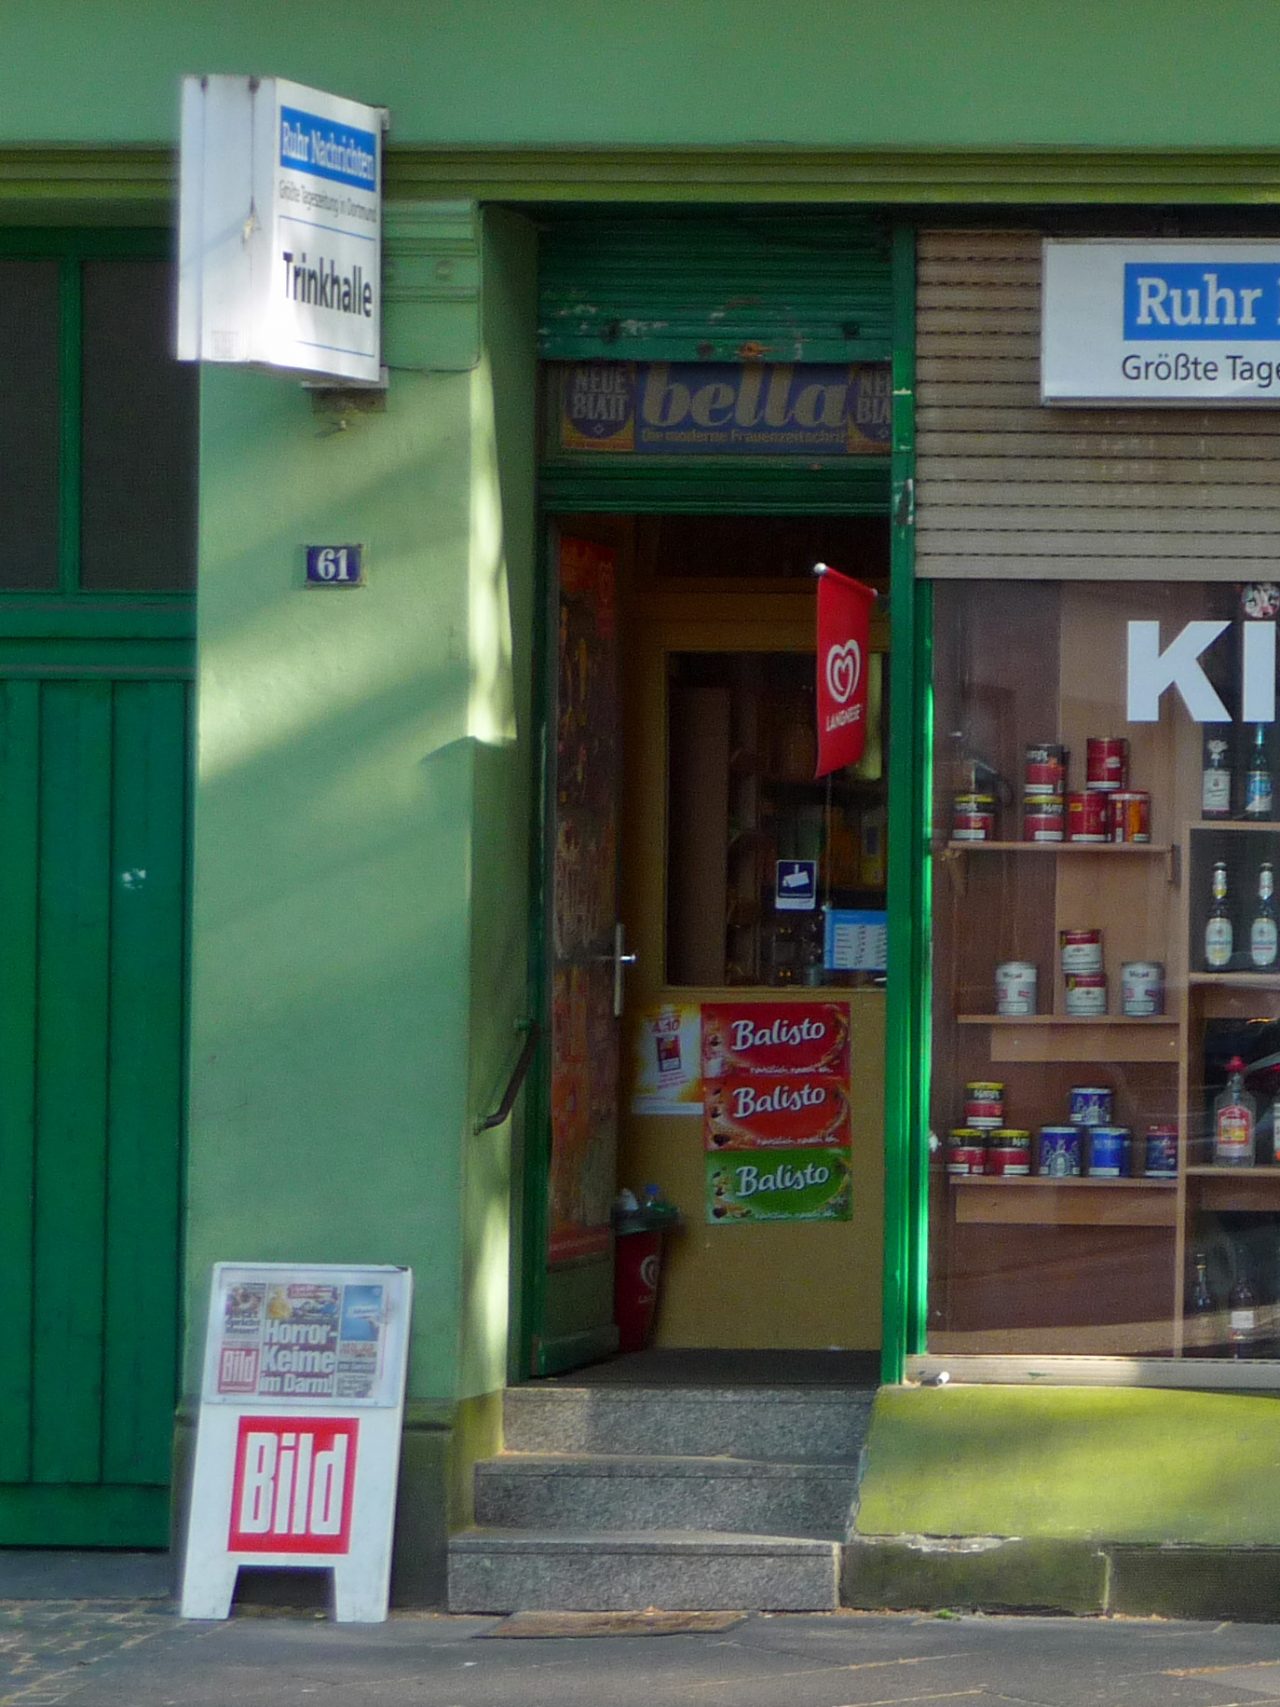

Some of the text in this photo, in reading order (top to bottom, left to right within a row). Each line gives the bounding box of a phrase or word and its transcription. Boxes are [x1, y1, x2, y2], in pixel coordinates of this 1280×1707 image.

[282, 121, 375, 181] Ruhr Nachrichten
[283, 251, 372, 318] Trinkhalle
[1136, 272, 1262, 326] Ruhr
[574, 369, 626, 393] NEUE
[1121, 353, 1219, 383] Größte
[572, 394, 628, 421] BLATT
[641, 362, 849, 428] bella
[317, 549, 350, 581] 61
[825, 703, 862, 733] LANGNESE
[731, 1017, 826, 1051] Balisto
[732, 1083, 826, 1119] Balisto
[735, 1163, 829, 1198] Balisto
[264, 1319, 339, 1345] Horror-
[222, 1349, 257, 1383] Bild
[262, 1346, 336, 1374] Keime
[259, 1374, 280, 1392] im
[238, 1431, 349, 1536] Bild
